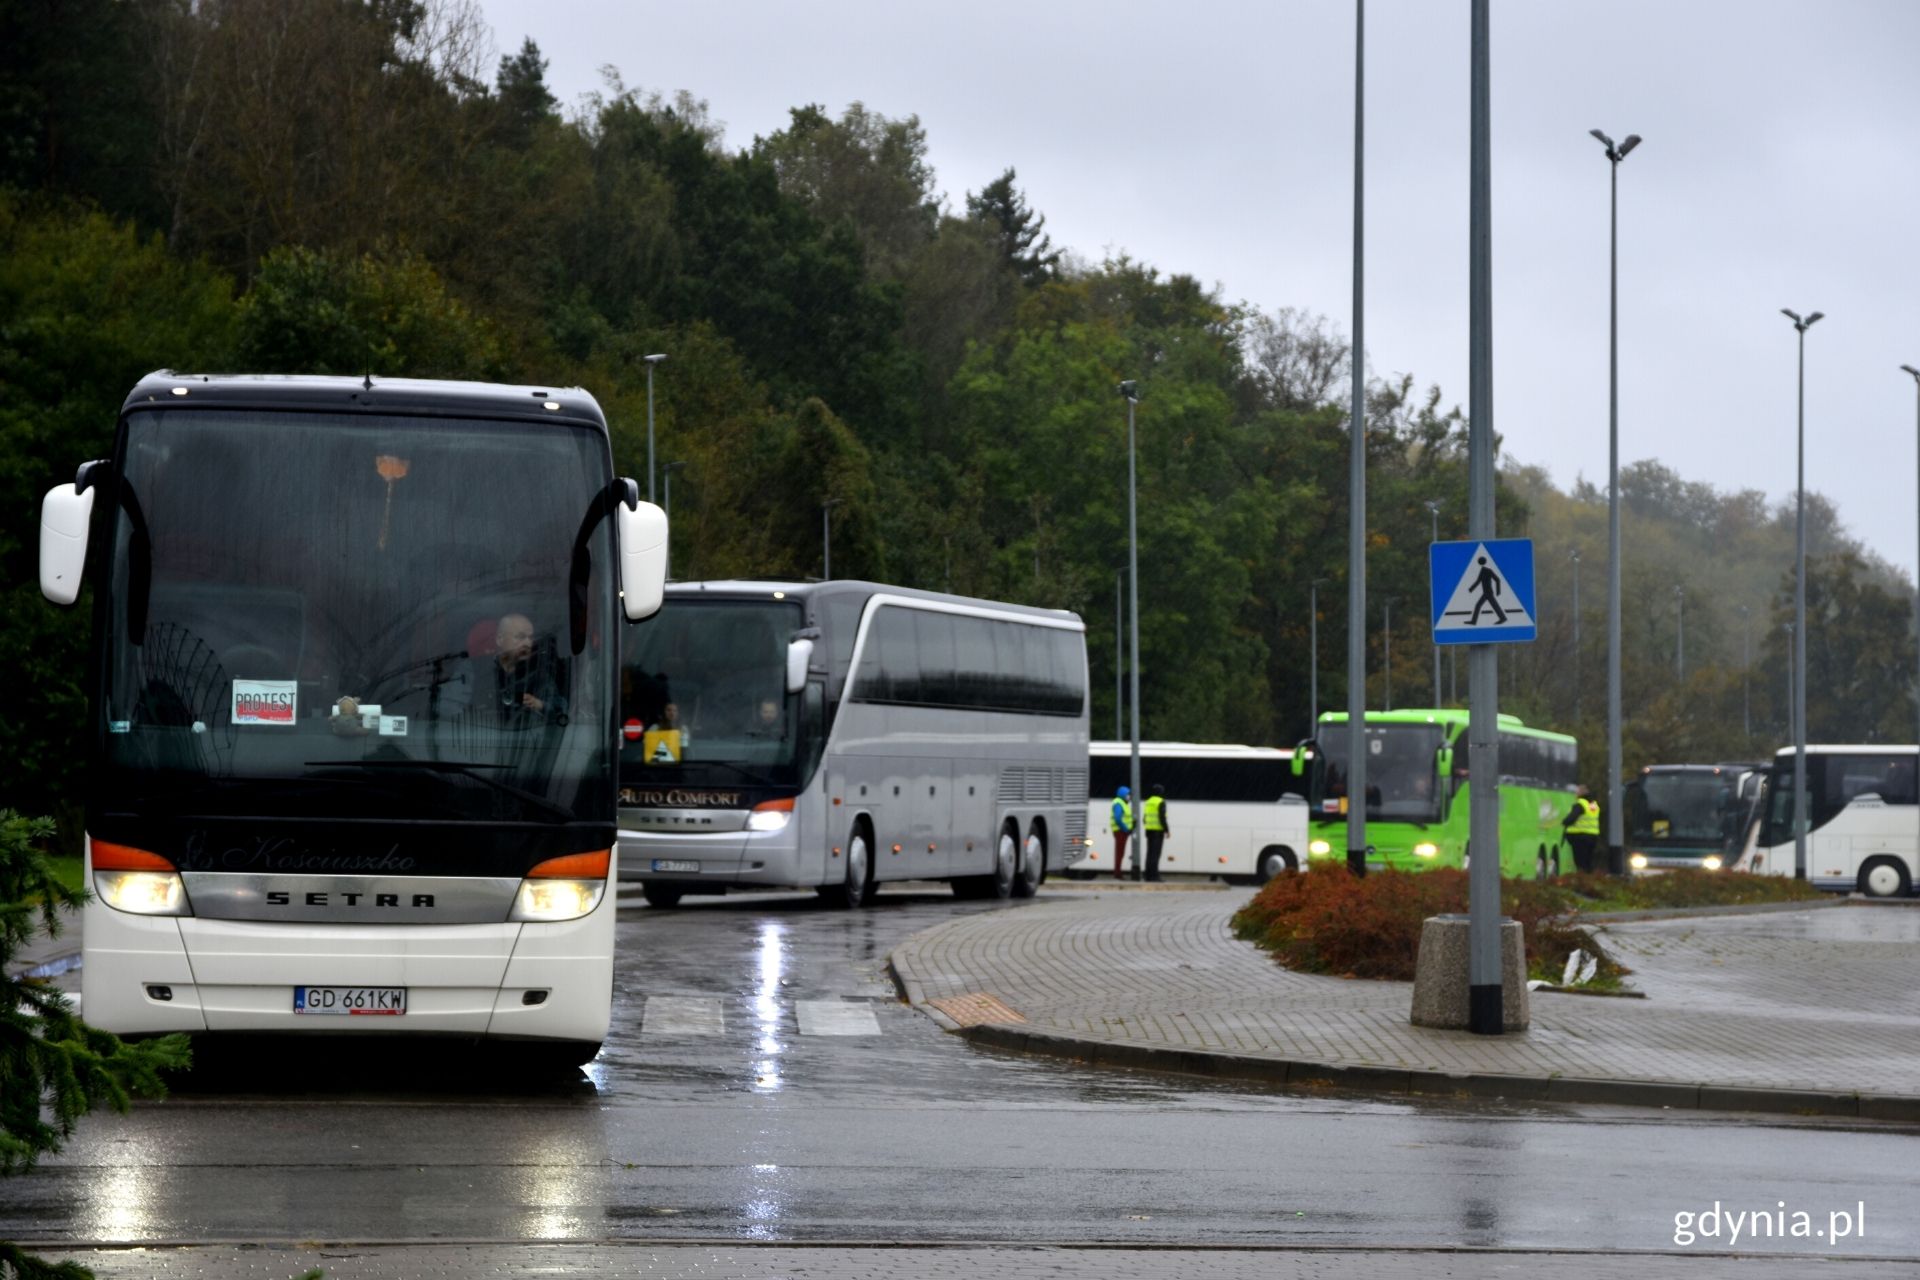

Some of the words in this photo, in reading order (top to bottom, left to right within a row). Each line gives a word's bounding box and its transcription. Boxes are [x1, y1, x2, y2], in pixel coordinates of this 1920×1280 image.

[235, 692, 296, 712] PROTEST
[617, 788, 663, 804] AUTO
[666, 789, 740, 806] COMFORT
[641, 816, 712, 825] SETRA
[222, 835, 417, 869] Kościuszko
[266, 891, 435, 908] SETRA
[308, 989, 336, 1008] GD
[342, 989, 402, 1009] 661KW
